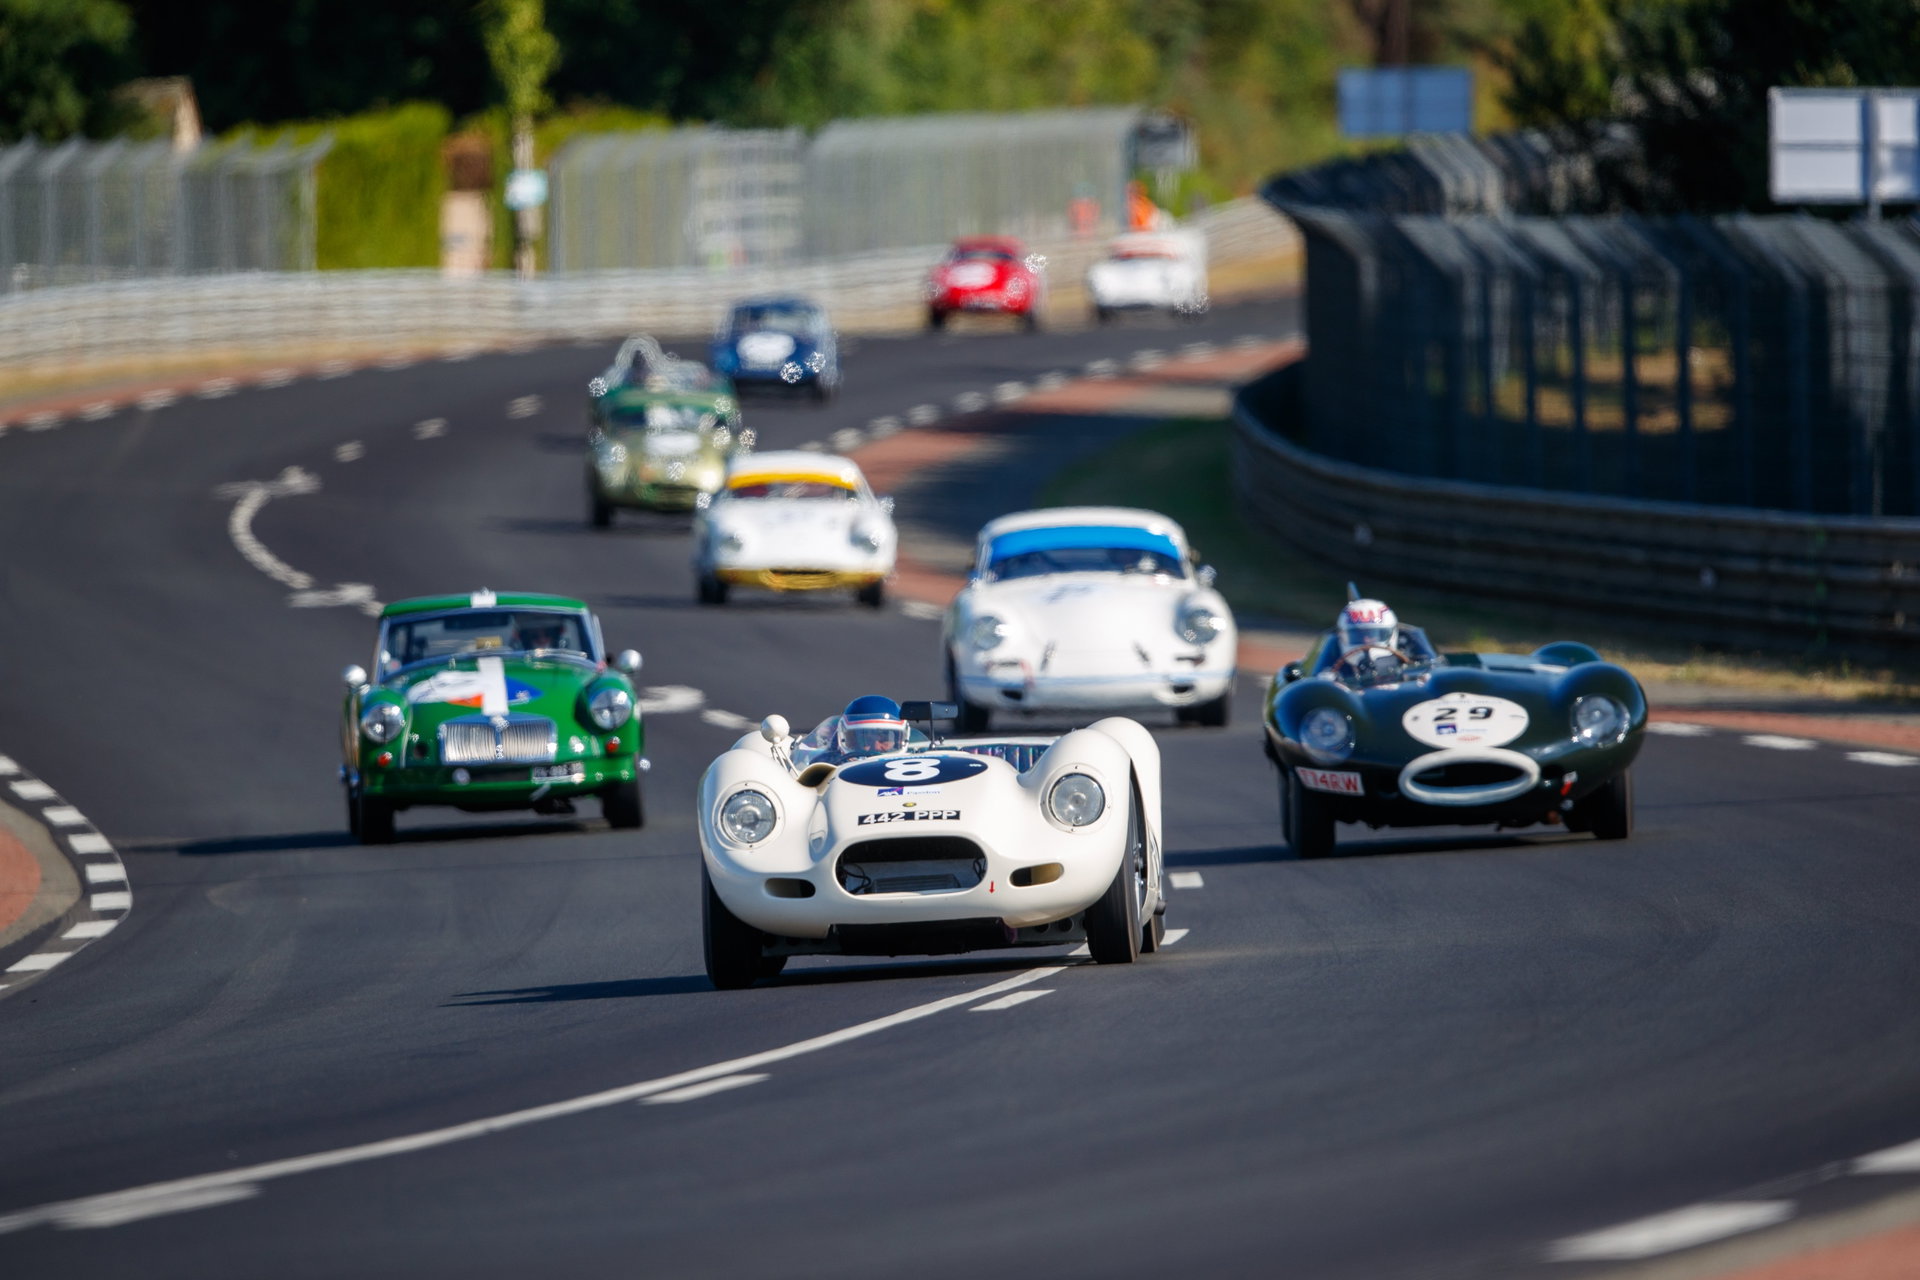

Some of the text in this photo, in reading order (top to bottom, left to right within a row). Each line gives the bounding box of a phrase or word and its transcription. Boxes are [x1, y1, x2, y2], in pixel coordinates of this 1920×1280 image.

[1432, 706, 1494, 721] 29
[884, 758, 940, 781] 8
[862, 810, 957, 824] 442 PPP
